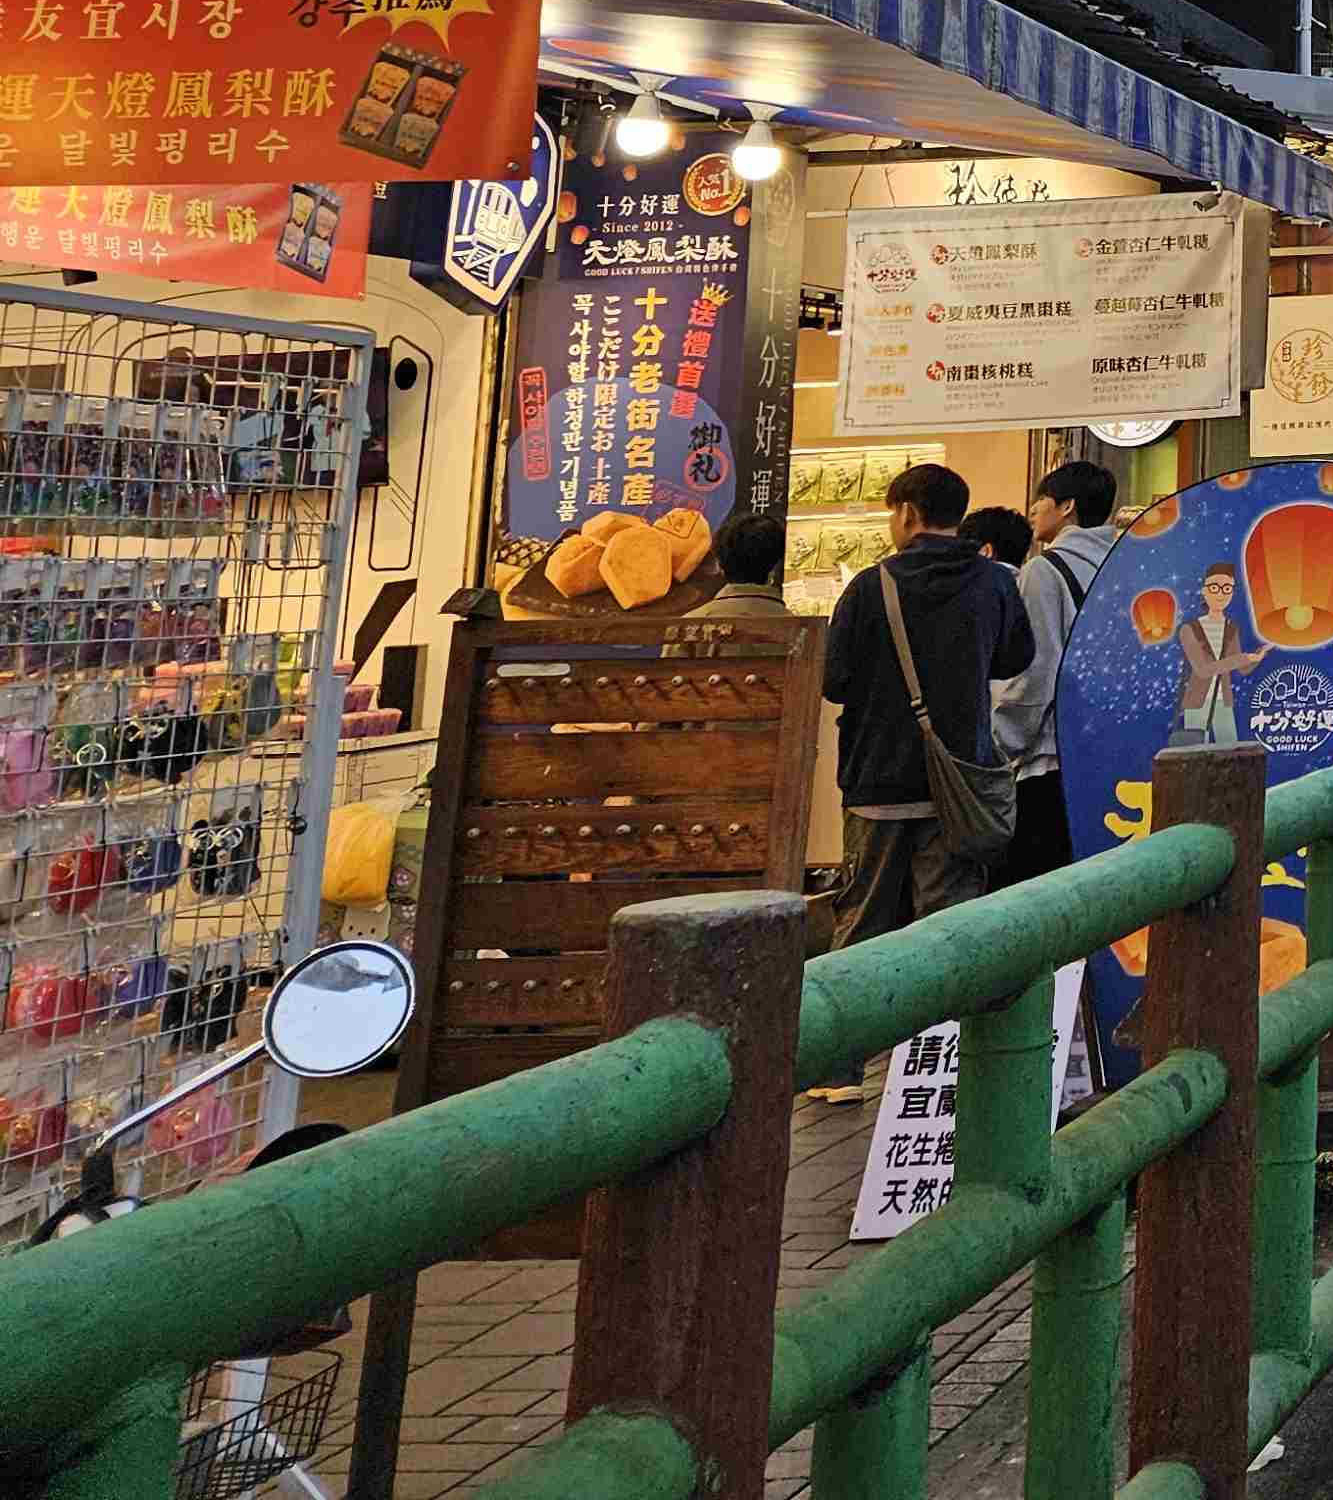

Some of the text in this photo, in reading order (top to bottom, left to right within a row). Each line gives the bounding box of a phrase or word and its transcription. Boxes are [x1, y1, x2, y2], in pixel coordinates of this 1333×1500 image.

[597, 194, 680, 218] 十分好運
[602, 220, 673, 233] Since 2012
[582, 234, 738, 265] 天燈鳳梨酥
[555, 294, 594, 522] 꼭 사야할 한정판 기념품
[1266, 735, 1318, 744] GOOD LUCK
[1275, 743, 1307, 752] SHIFEN
